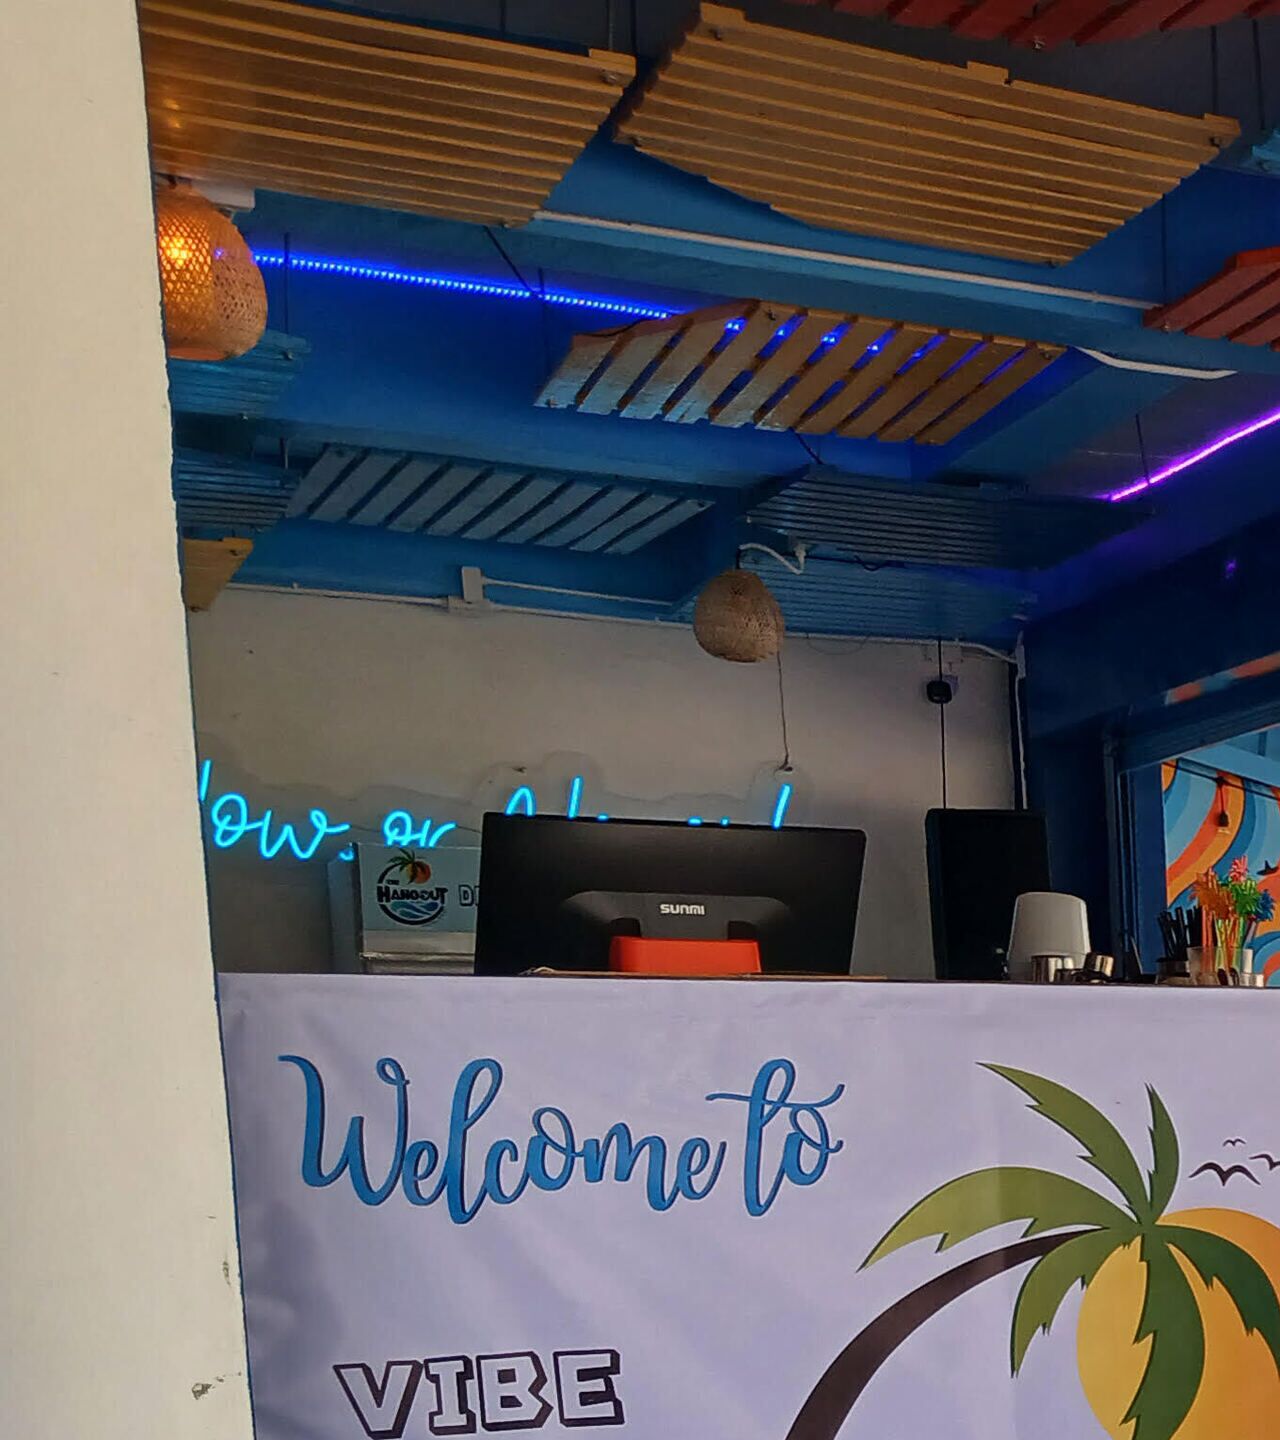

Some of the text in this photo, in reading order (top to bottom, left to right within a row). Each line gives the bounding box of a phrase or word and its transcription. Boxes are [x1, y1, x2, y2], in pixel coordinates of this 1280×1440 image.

[278, 1054, 846, 1225] Welcome to
[333, 1348, 626, 1440] VIBE
